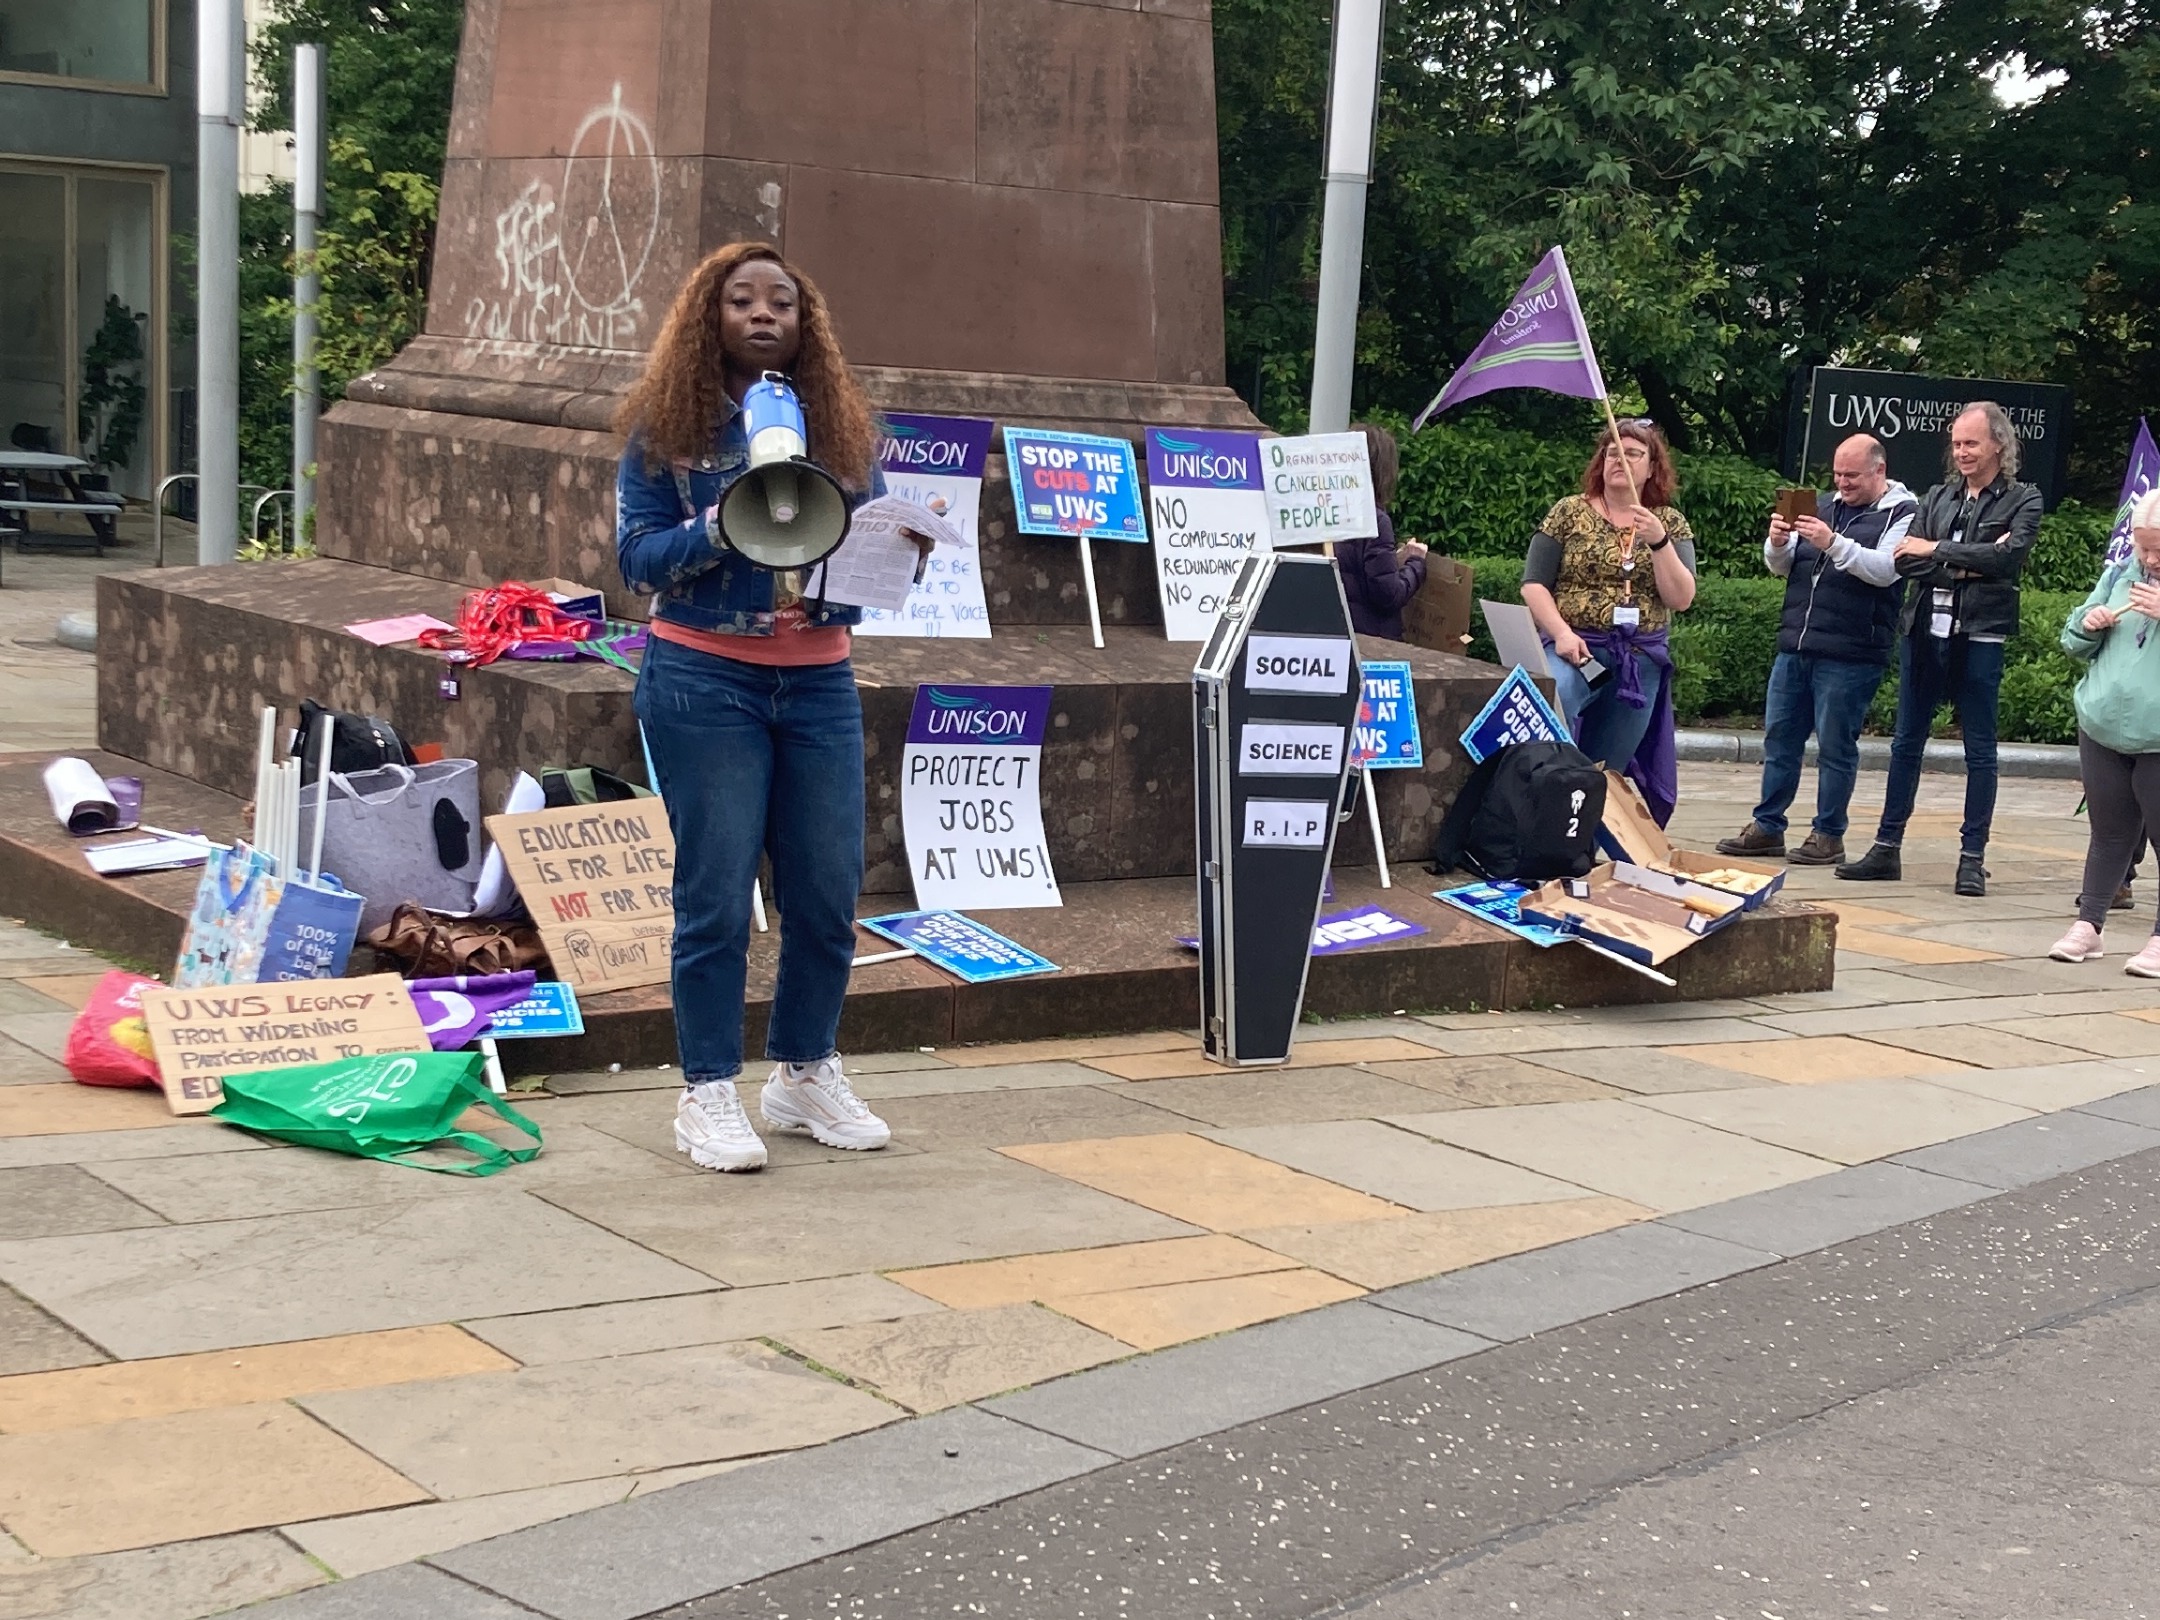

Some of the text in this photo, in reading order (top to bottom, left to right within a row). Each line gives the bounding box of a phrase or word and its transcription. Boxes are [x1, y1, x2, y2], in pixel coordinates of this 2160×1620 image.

[1829, 394, 1902, 438] UWS
[1905, 415, 1946, 432] WEST
[1906, 400, 1967, 417] UNIVER
[2020, 408, 2046, 424] THE
[1022, 446, 1124, 473] STOP THE
[1164, 454, 1247, 480] UNISON
[1272, 445, 1367, 467] ORGANISATIONAL
[1034, 469, 1118, 494] CUTS AT
[1275, 474, 1359, 494] CANCELLATION
[1055, 494, 1108, 524] UWS
[1317, 493, 1332, 507] OF
[1156, 496, 1187, 529] NO
[1169, 530, 1255, 548] COMPULSORY
[929, 560, 971, 576] TO BE
[1164, 558, 1240, 576] REDUNDANC
[939, 584, 960, 594] TO
[1166, 583, 1192, 606] NO
[911, 603, 944, 620] REAL
[951, 603, 987, 621] VOICE
[1198, 595, 1225, 613] EX
[1256, 656, 1335, 677] SOCIAL
[1365, 679, 1402, 698] THE
[928, 710, 1027, 735] UNISON
[1377, 701, 1397, 722] AT
[1503, 708, 1531, 743] OUR
[1249, 743, 1333, 760] SCIENCE
[1352, 727, 1388, 754] WS
[911, 755, 1030, 789] PROTECT
[939, 799, 1014, 833] JOBS
[1566, 818, 1579, 837] 2
[567, 854, 613, 881] FOR
[924, 847, 957, 880] AT
[550, 884, 673, 922] NOT FOR PR
[297, 925, 339, 945] 100%
[913, 926, 944, 938] AT
[938, 939, 984, 961] UWS
[923, 920, 965, 940] OUR
[960, 940, 1011, 965] JOBS
[931, 914, 1034, 966] DEFENDING
[286, 940, 334, 959] of this
[603, 942, 648, 967] QUALITY
[164, 996, 271, 1020] UWS
[286, 994, 375, 1013] LEGACY
[485, 1008, 564, 1018] ANCIES
[171, 1028, 228, 1045] FROM
[335, 1044, 363, 1058] TO
[181, 1076, 223, 1099] ED
